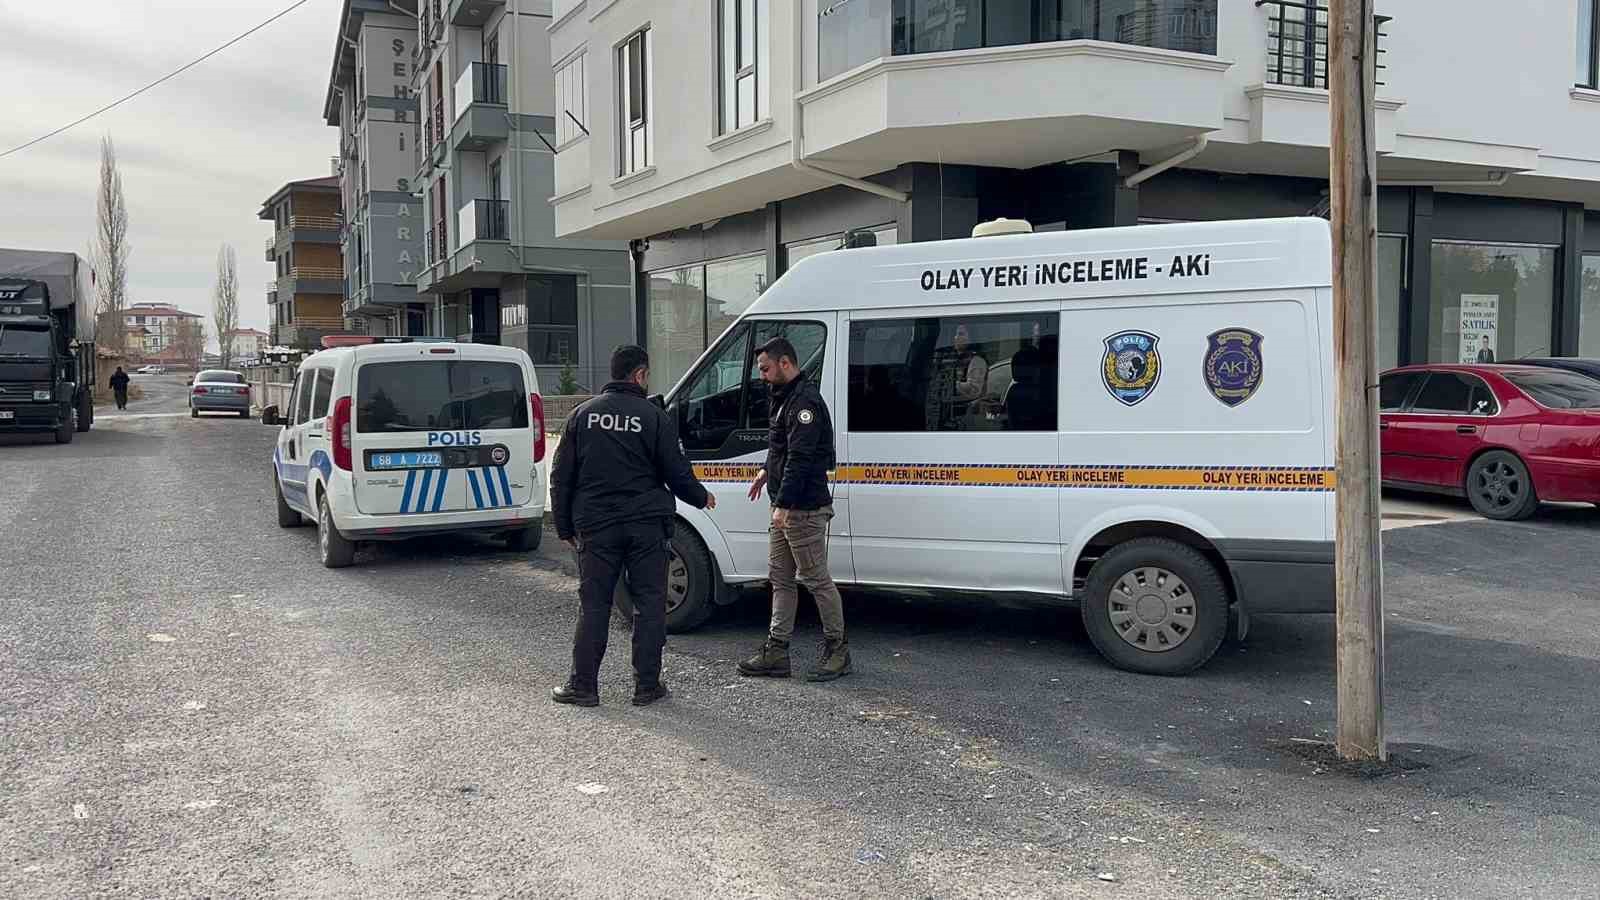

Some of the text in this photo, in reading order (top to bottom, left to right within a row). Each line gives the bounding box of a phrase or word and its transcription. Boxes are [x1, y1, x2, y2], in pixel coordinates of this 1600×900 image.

[397, 178, 413, 284] SARAY
[920, 267, 973, 291] OLAY
[703, 467, 724, 478] OLAY
[864, 468, 888, 479] OLAY
[1016, 470, 1043, 481] OLAY
[1202, 472, 1232, 483] OLAY
